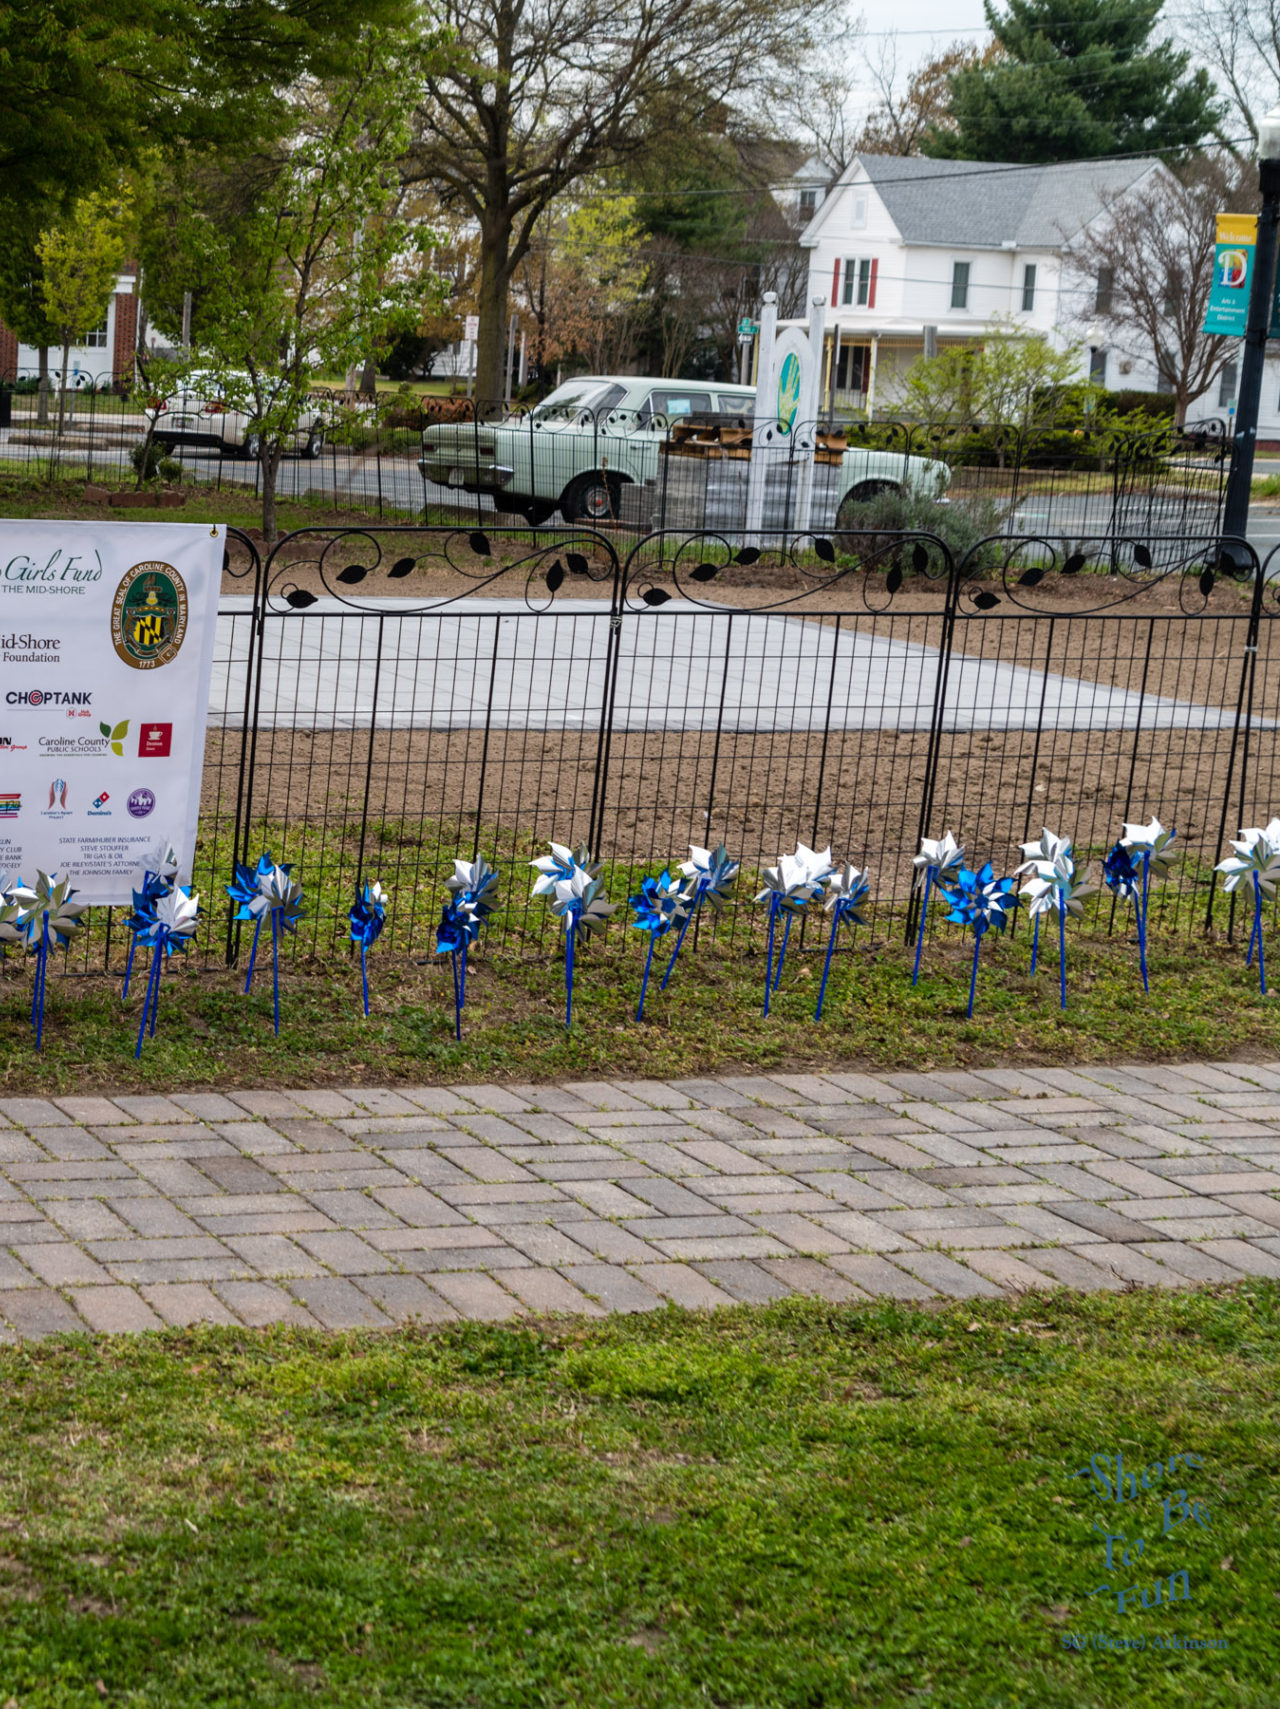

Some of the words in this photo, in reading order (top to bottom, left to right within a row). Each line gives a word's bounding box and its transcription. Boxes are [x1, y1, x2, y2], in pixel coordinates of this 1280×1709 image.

[5, 549, 62, 582] Girls
[60, 549, 103, 582] Fund
[130, 563, 164, 577] CAROLINE
[122, 577, 131, 587] OF
[165, 567, 185, 591] COUNTY
[1, 585, 24, 594] THE
[26, 585, 86, 595] MID-SHORE
[116, 589, 127, 605] SEAL
[179, 593, 186, 602] IN
[174, 603, 187, 645] MARYLAND
[113, 634, 122, 645] THE
[3, 651, 60, 663] Foundation
[139, 660, 155, 669] 1773
[6, 689, 92, 706] CHOPTANK
[38, 736, 76, 746] Caroline
[77, 736, 111, 748] County
